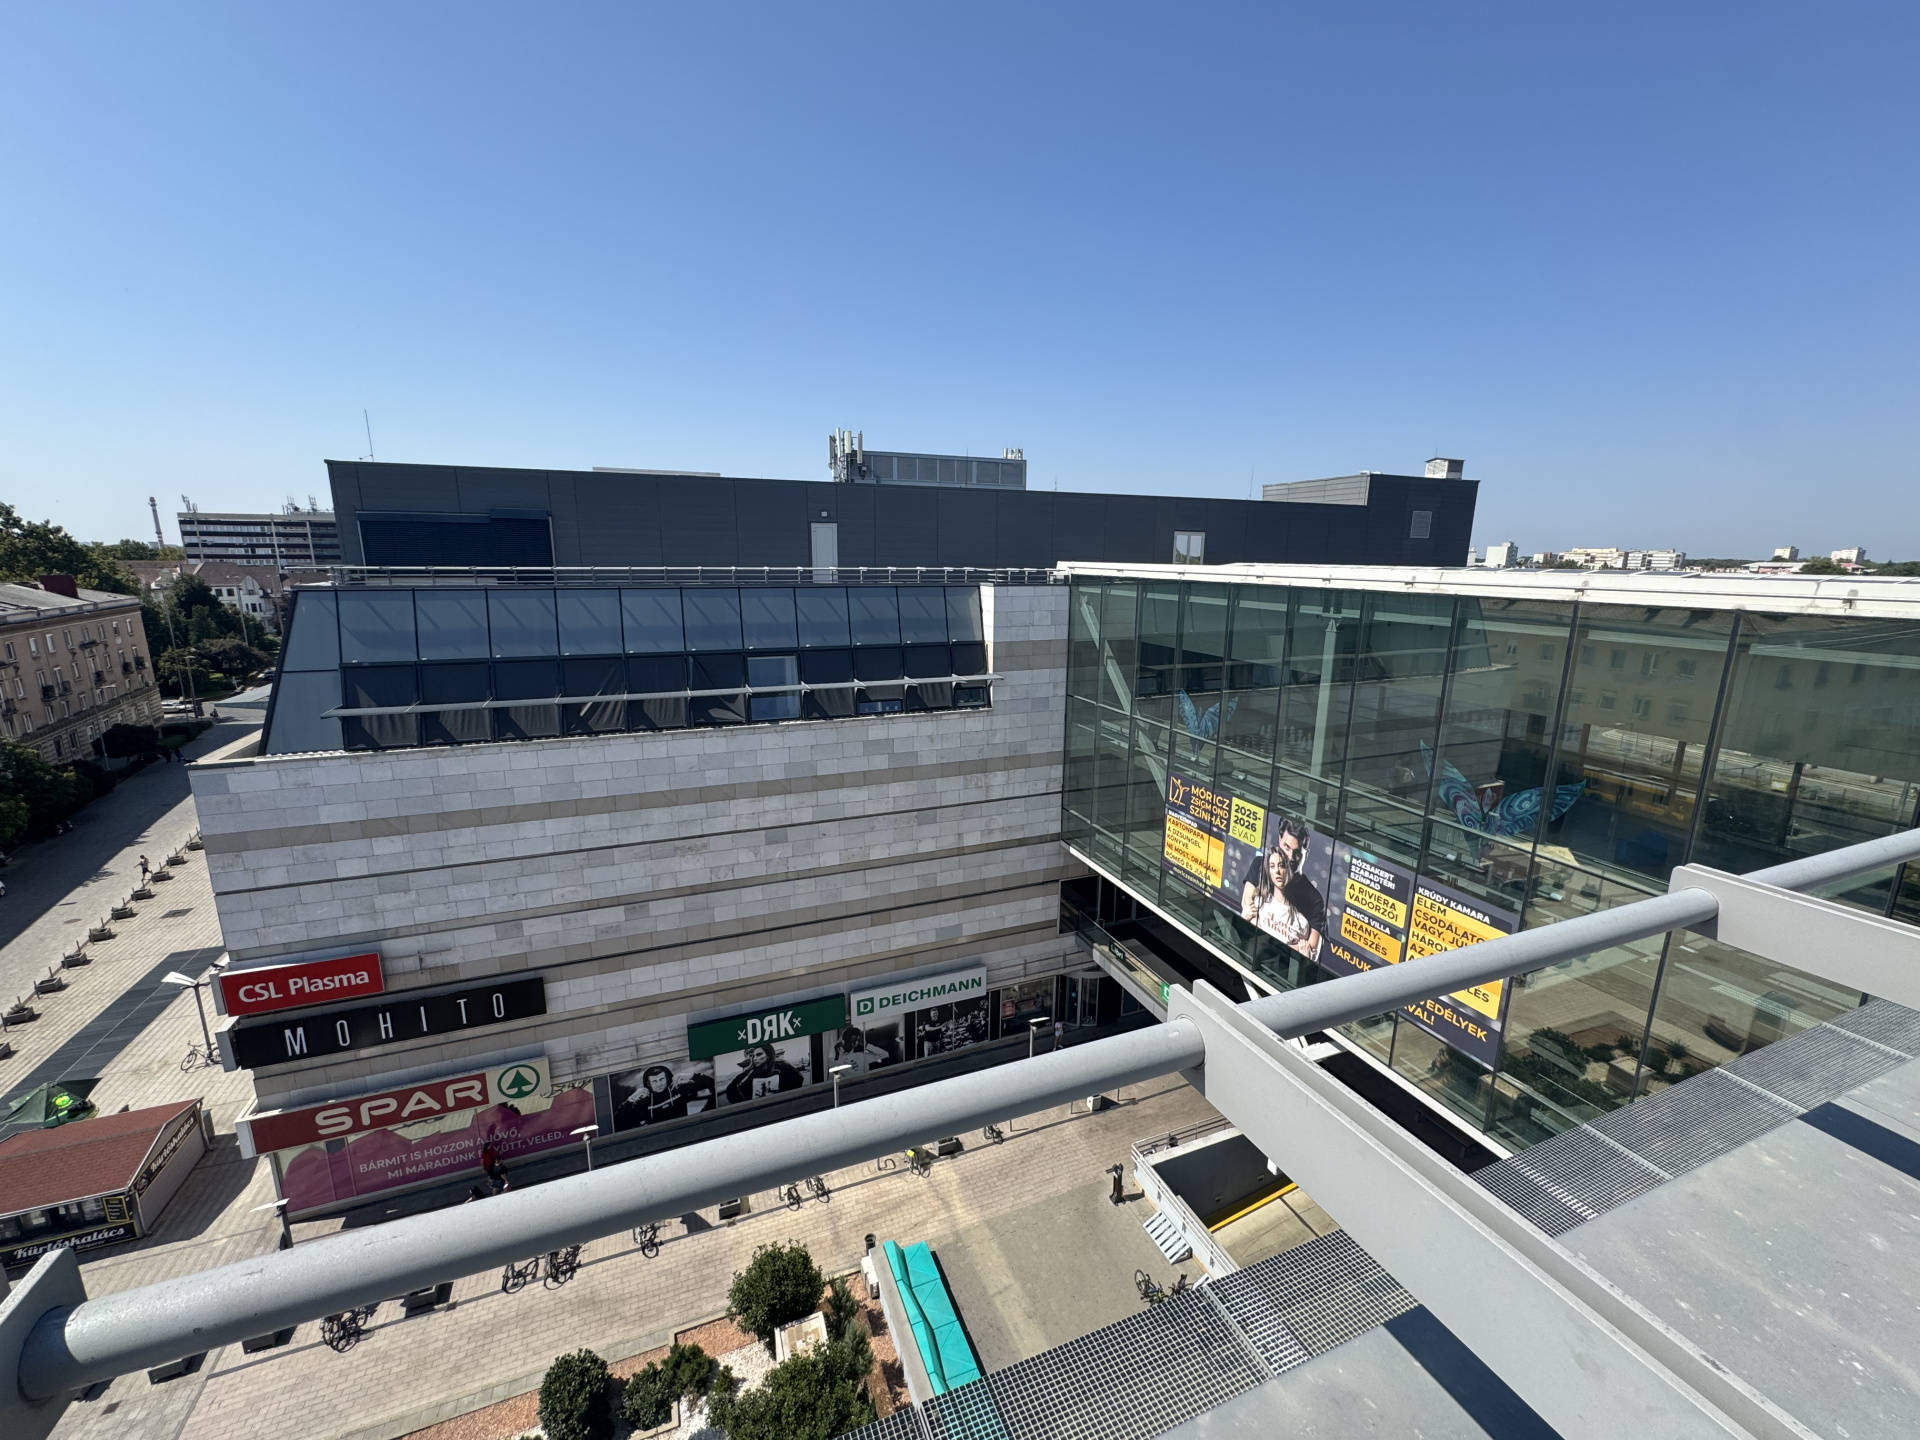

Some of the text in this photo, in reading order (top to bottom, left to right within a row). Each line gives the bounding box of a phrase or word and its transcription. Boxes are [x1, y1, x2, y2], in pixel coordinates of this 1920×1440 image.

[1190, 796, 1228, 818] ZSIGMOND
[1191, 784, 1230, 810] MÓRICZ
[1190, 805, 1227, 830] SZÍNHÁZ
[1234, 804, 1261, 821] 2025-
[1234, 815, 1257, 832] 2026
[1168, 818, 1204, 841] KARTONPAPA
[1172, 828, 1201, 848] DZSUNGEL
[1232, 825, 1256, 843] ÉVAD
[1166, 841, 1173, 850] NE
[1167, 834, 1189, 850] KÖNYVE
[1350, 872, 1380, 890] SZÍNPAD
[1351, 865, 1396, 890] SZABADTÉRI
[1352, 858, 1395, 881] RÓZSAKERT
[1349, 891, 1398, 922] VADORZÓI
[1358, 887, 1396, 911] RIVIÉRA
[1416, 897, 1447, 916] ELEM
[1418, 887, 1490, 924] KRÚDY KAMARA
[1345, 918, 1381, 940] ARANY-
[1346, 907, 1390, 935] BENCS VILLA
[1414, 918, 1445, 942] VAGY,
[1415, 909, 1485, 944] CSODÁLATO
[1344, 927, 1387, 956] METSZÉS
[1410, 943, 1425, 956] AZ
[1330, 943, 1371, 972] VÁRJUK
[238, 969, 370, 1004] CSL Plasma
[879, 976, 982, 1009] DEICHMANN
[284, 992, 506, 1056] MOHITO
[1404, 1005, 1435, 1026] VAL!
[315, 1079, 483, 1135] SPAR
[359, 1152, 408, 1173] BÁRMIT
[410, 1150, 421, 1161] IS
[424, 1139, 474, 1158] HOZZON
[475, 1137, 485, 1147] A
[387, 1169, 403, 1180] MI
[406, 1151, 476, 1175] MARADUNK
[526, 1130, 565, 1146] VELED.
[14, 1227, 125, 1259] Kürtőskalács
